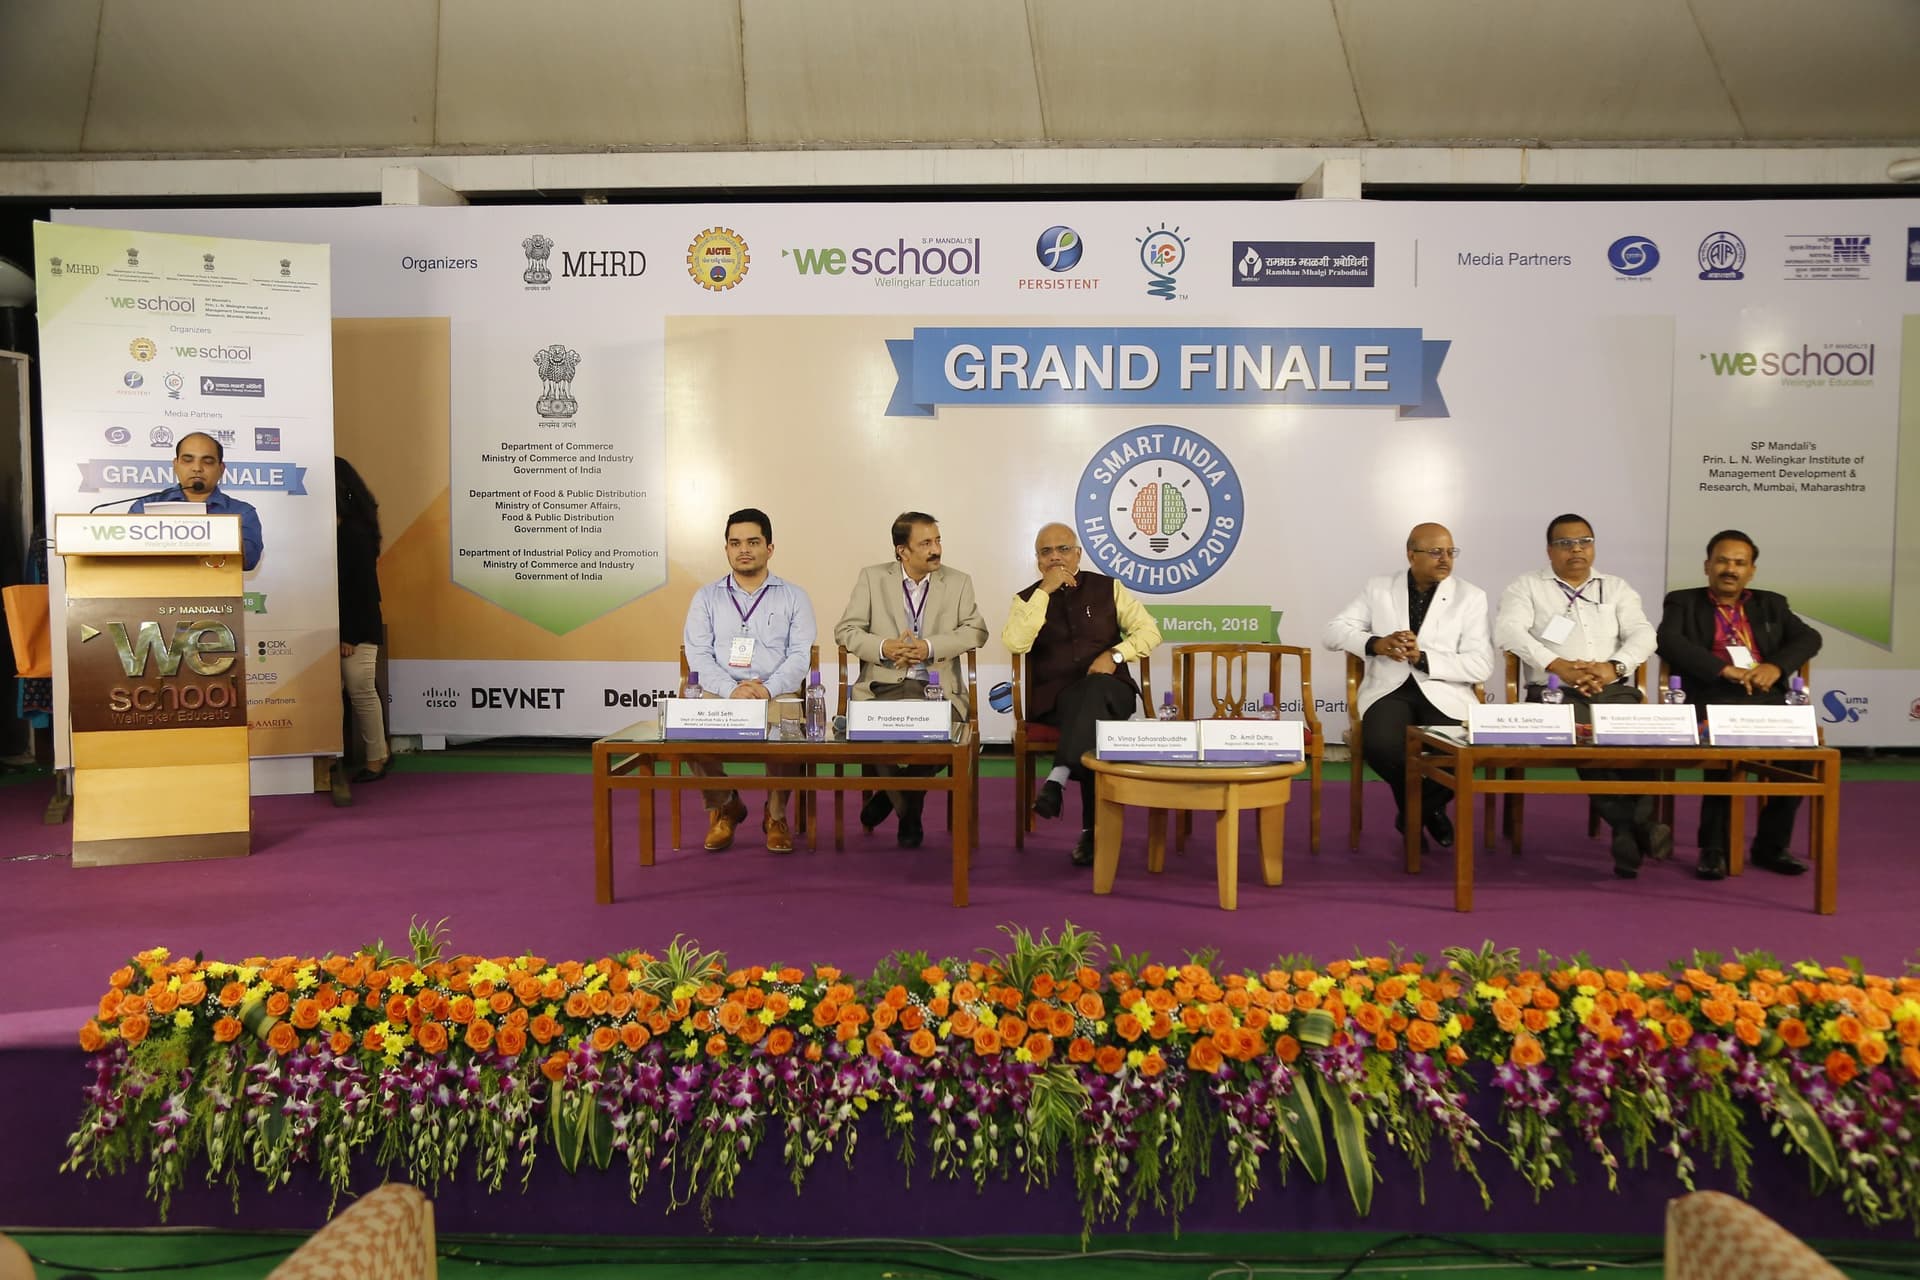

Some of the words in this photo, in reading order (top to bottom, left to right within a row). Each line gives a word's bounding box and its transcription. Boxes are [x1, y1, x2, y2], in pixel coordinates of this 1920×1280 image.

[401, 256, 478, 272] Organizers
[562, 251, 647, 277] MHRD
[1458, 252, 1504, 266] Media
[1508, 252, 1572, 266] Partners
[66, 263, 100, 275] MHRD
[1301, 268, 1327, 277] Mhalgi
[1328, 268, 1368, 276] Prabodhini
[874, 277, 926, 289] Welingkar
[929, 277, 980, 287] Education
[1019, 279, 1100, 290] PERSISTENT
[169, 325, 212, 335] Organizers
[944, 343, 1160, 391] GRAND
[1180, 344, 1390, 391] FINALE
[164, 410, 189, 418] Media
[191, 410, 223, 419] Partners
[501, 442, 553, 452] Department
[555, 442, 564, 452] of
[565, 442, 614, 452] Commerce
[1751, 441, 1766, 451] SP
[1768, 441, 1817, 451] Mandali's
[482, 454, 516, 464] Ministry
[519, 454, 528, 464] of
[529, 454, 577, 464] Commerce
[579, 454, 596, 464] and
[598, 454, 634, 464] Industry
[1094, 434, 1164, 484] SMART
[1172, 436, 1227, 488] INDIA
[1703, 455, 1726, 465] Prin.
[1729, 455, 1738, 465] L.
[1741, 455, 1752, 465] N.
[1755, 455, 1806, 465] Welingkar
[1809, 455, 1851, 465] Institute
[1854, 455, 1865, 465] of
[513, 466, 567, 474] Government
[569, 466, 579, 474] of
[580, 466, 602, 474] India
[1709, 469, 1776, 479] Management
[1779, 469, 1847, 479] Development
[1849, 469, 1857, 479] &
[103, 465, 179, 485] GRAN
[218, 467, 285, 486] NALE
[1700, 482, 1751, 493] Research,
[1753, 482, 1798, 493] Mumbai,
[1800, 482, 1866, 493] Maharashtra
[469, 489, 521, 499] Department
[523, 489, 532, 499] of
[533, 489, 556, 499] Food
[558, 489, 565, 499] &
[567, 489, 594, 499] Public
[596, 489, 647, 499] Distribution
[495, 502, 530, 512] Ministry
[532, 502, 541, 512] of
[543, 502, 588, 512] Consumer
[590, 502, 621, 512] Affairs,
[502, 513, 524, 522] Food
[526, 513, 532, 522] &
[534, 513, 562, 522] Public
[564, 513, 615, 522] Distribution
[514, 525, 568, 534] Government
[569, 525, 579, 534] of
[581, 525, 602, 534] India
[459, 548, 511, 559] Department
[512, 548, 522, 559] of
[524, 548, 564, 559] Industrial
[566, 548, 593, 559] Policy
[594, 548, 611, 559] and
[613, 548, 659, 559] Promotion
[1084, 516, 1199, 586] HACKATHON
[1198, 516, 1235, 567] 2018
[483, 560, 518, 570] Ministry
[520, 560, 529, 570] of
[531, 560, 579, 570] Commerce
[580, 560, 597, 570] and
[599, 560, 635, 570] Industry
[515, 572, 569, 581] Government
[570, 572, 580, 581] of
[581, 572, 603, 581] India
[159, 606, 165, 615] S
[169, 606, 176, 614] P
[180, 604, 233, 614] MANDALI'S
[1163, 617, 1217, 633] March,
[1221, 617, 1259, 631] 2018
[267, 640, 287, 649] CDK
[245, 672, 278, 681] CADES
[109, 676, 238, 712] school
[471, 687, 565, 709] DEVNET
[111, 711, 172, 725] Welingkar
[878, 715, 905, 723] Pradeep
[255, 719, 293, 728] AMRITA
